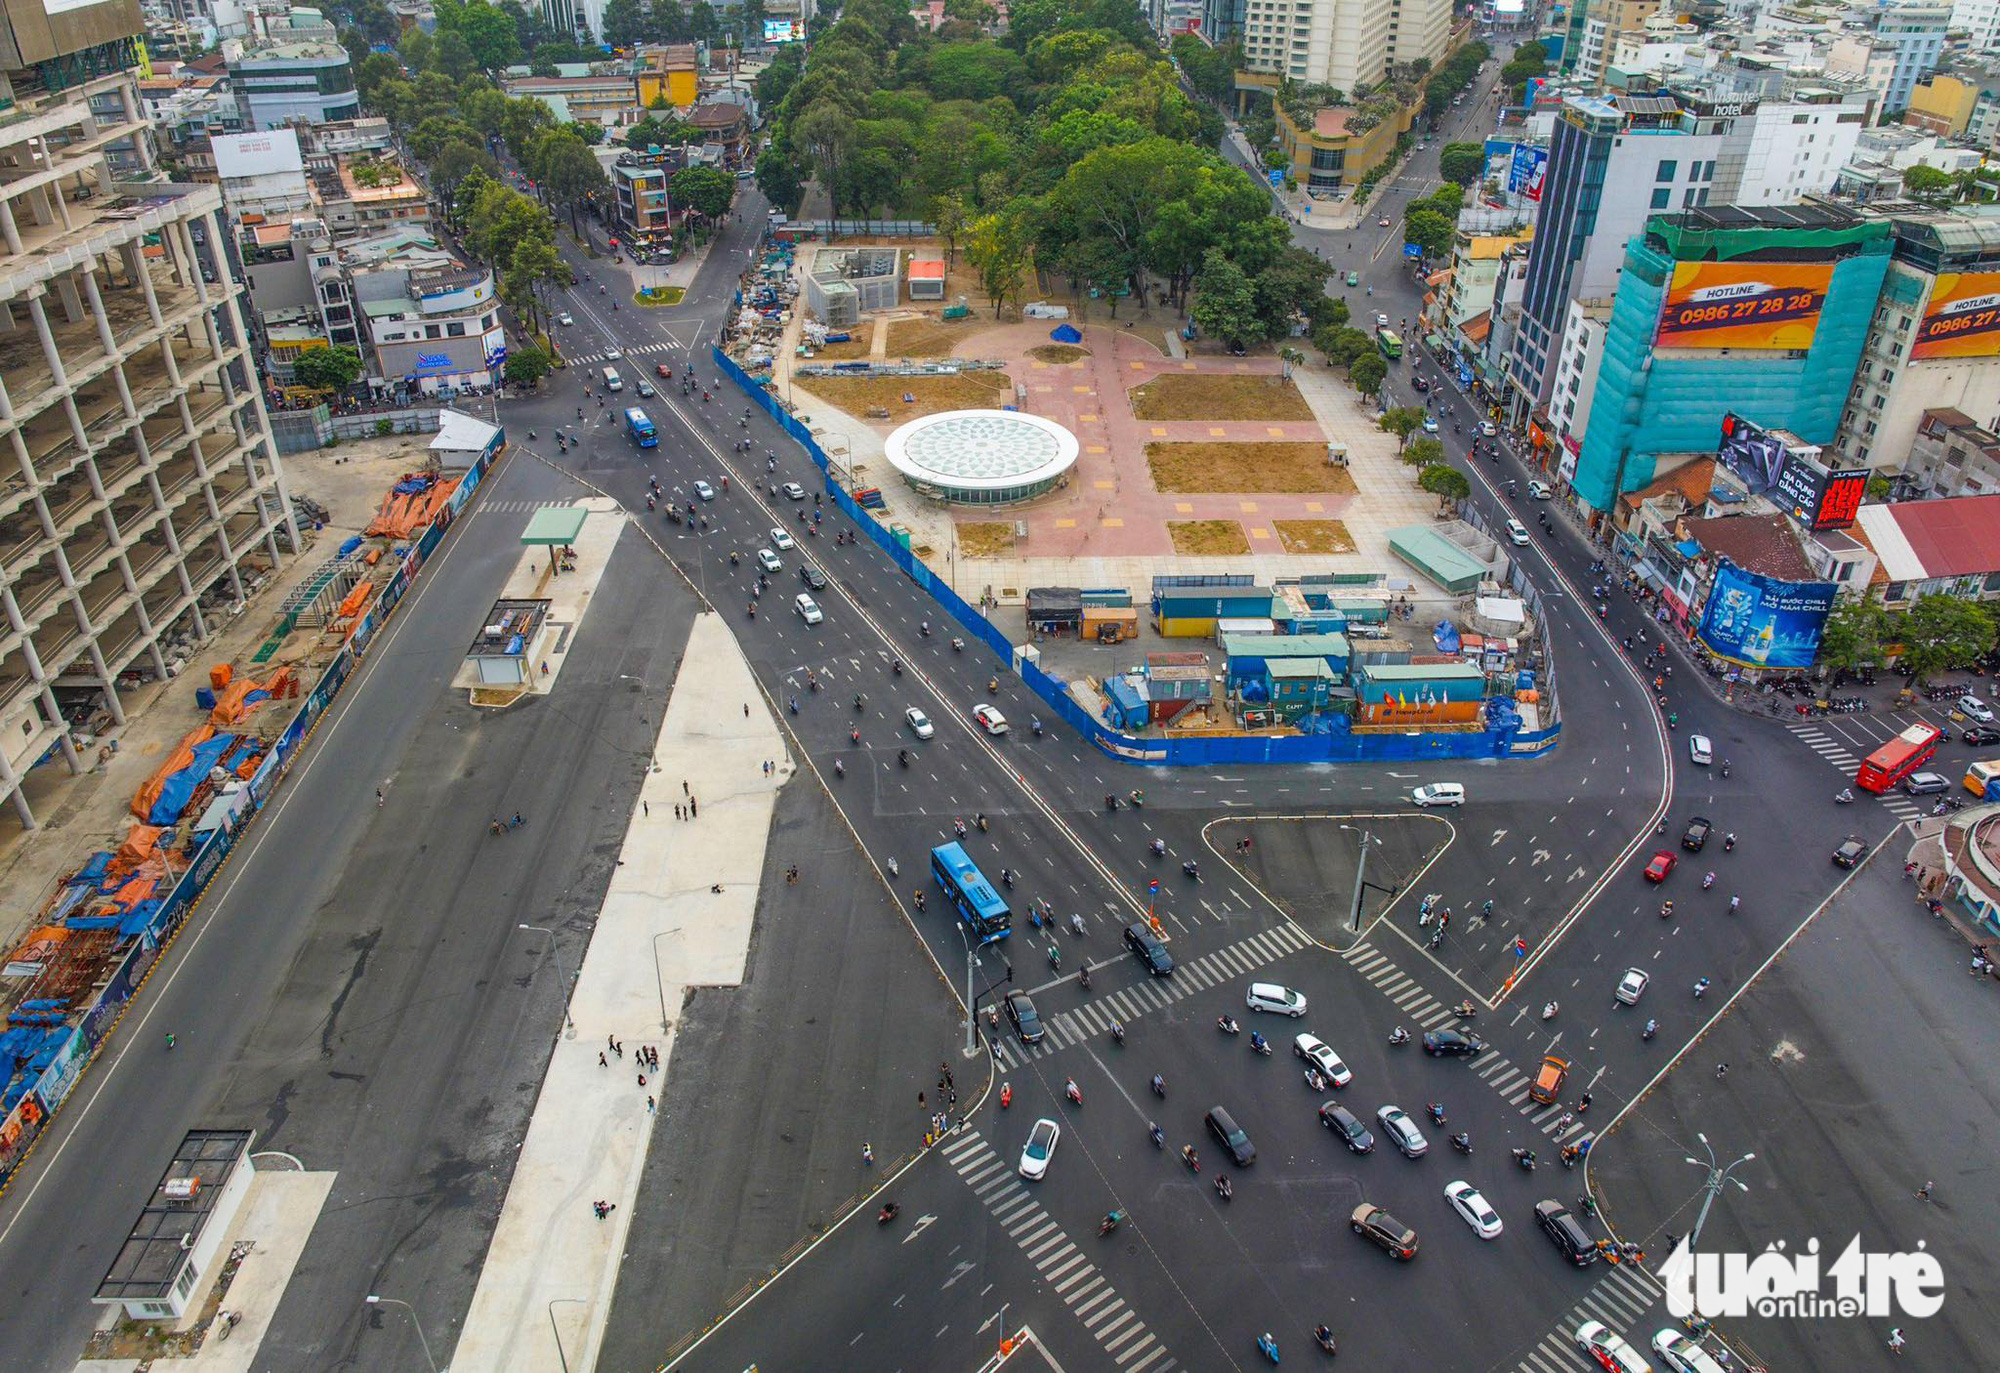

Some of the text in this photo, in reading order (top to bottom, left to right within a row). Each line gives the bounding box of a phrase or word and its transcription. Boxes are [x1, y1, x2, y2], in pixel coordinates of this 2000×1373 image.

[1713, 104, 1743, 115] hotel
[1706, 285, 1755, 298] HOTLINE
[1680, 294, 1813, 325] 0986 27 28 28
[1954, 297, 1996, 310] HOTLINE
[1930, 315, 1973, 335] 0986
[1973, 311, 1997, 327] 27
[1783, 470, 1795, 484] GIA
